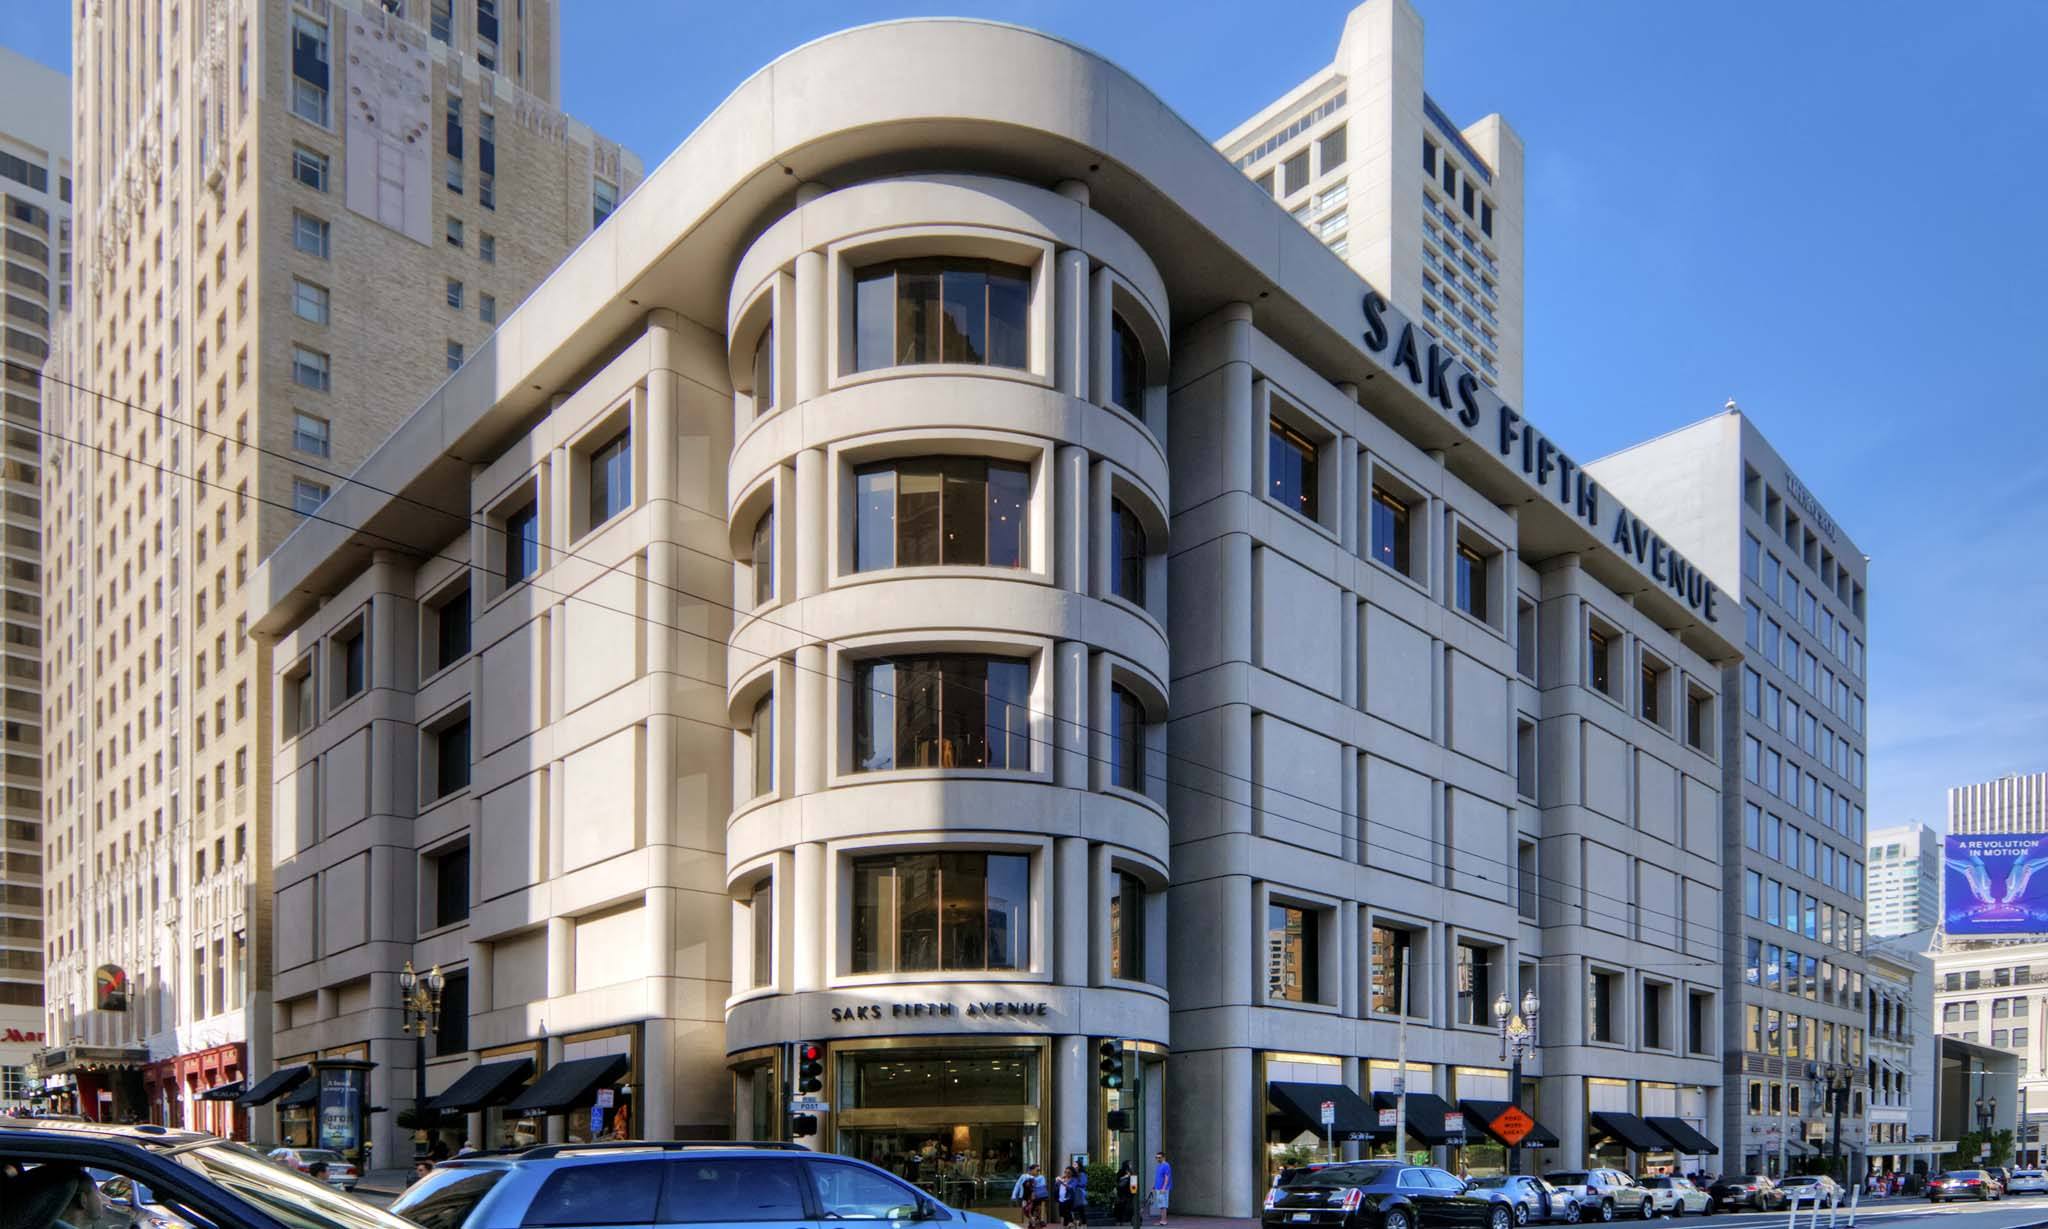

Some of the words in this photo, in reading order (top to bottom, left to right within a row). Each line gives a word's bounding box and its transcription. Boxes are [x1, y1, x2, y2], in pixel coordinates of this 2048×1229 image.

[1362, 291, 1480, 428] SAKS
[1500, 404, 1599, 526] FIFTH
[1613, 508, 1719, 623] AVENUE
[1960, 841, 1967, 849] A
[1968, 840, 2039, 849] REVOLUTION
[1969, 849, 1981, 857] IN
[1983, 848, 2029, 856] MOTION
[831, 1004, 882, 1022] SAKS
[892, 1002, 952, 1018] FIFTH
[965, 1001, 1048, 1017] AVENUE
